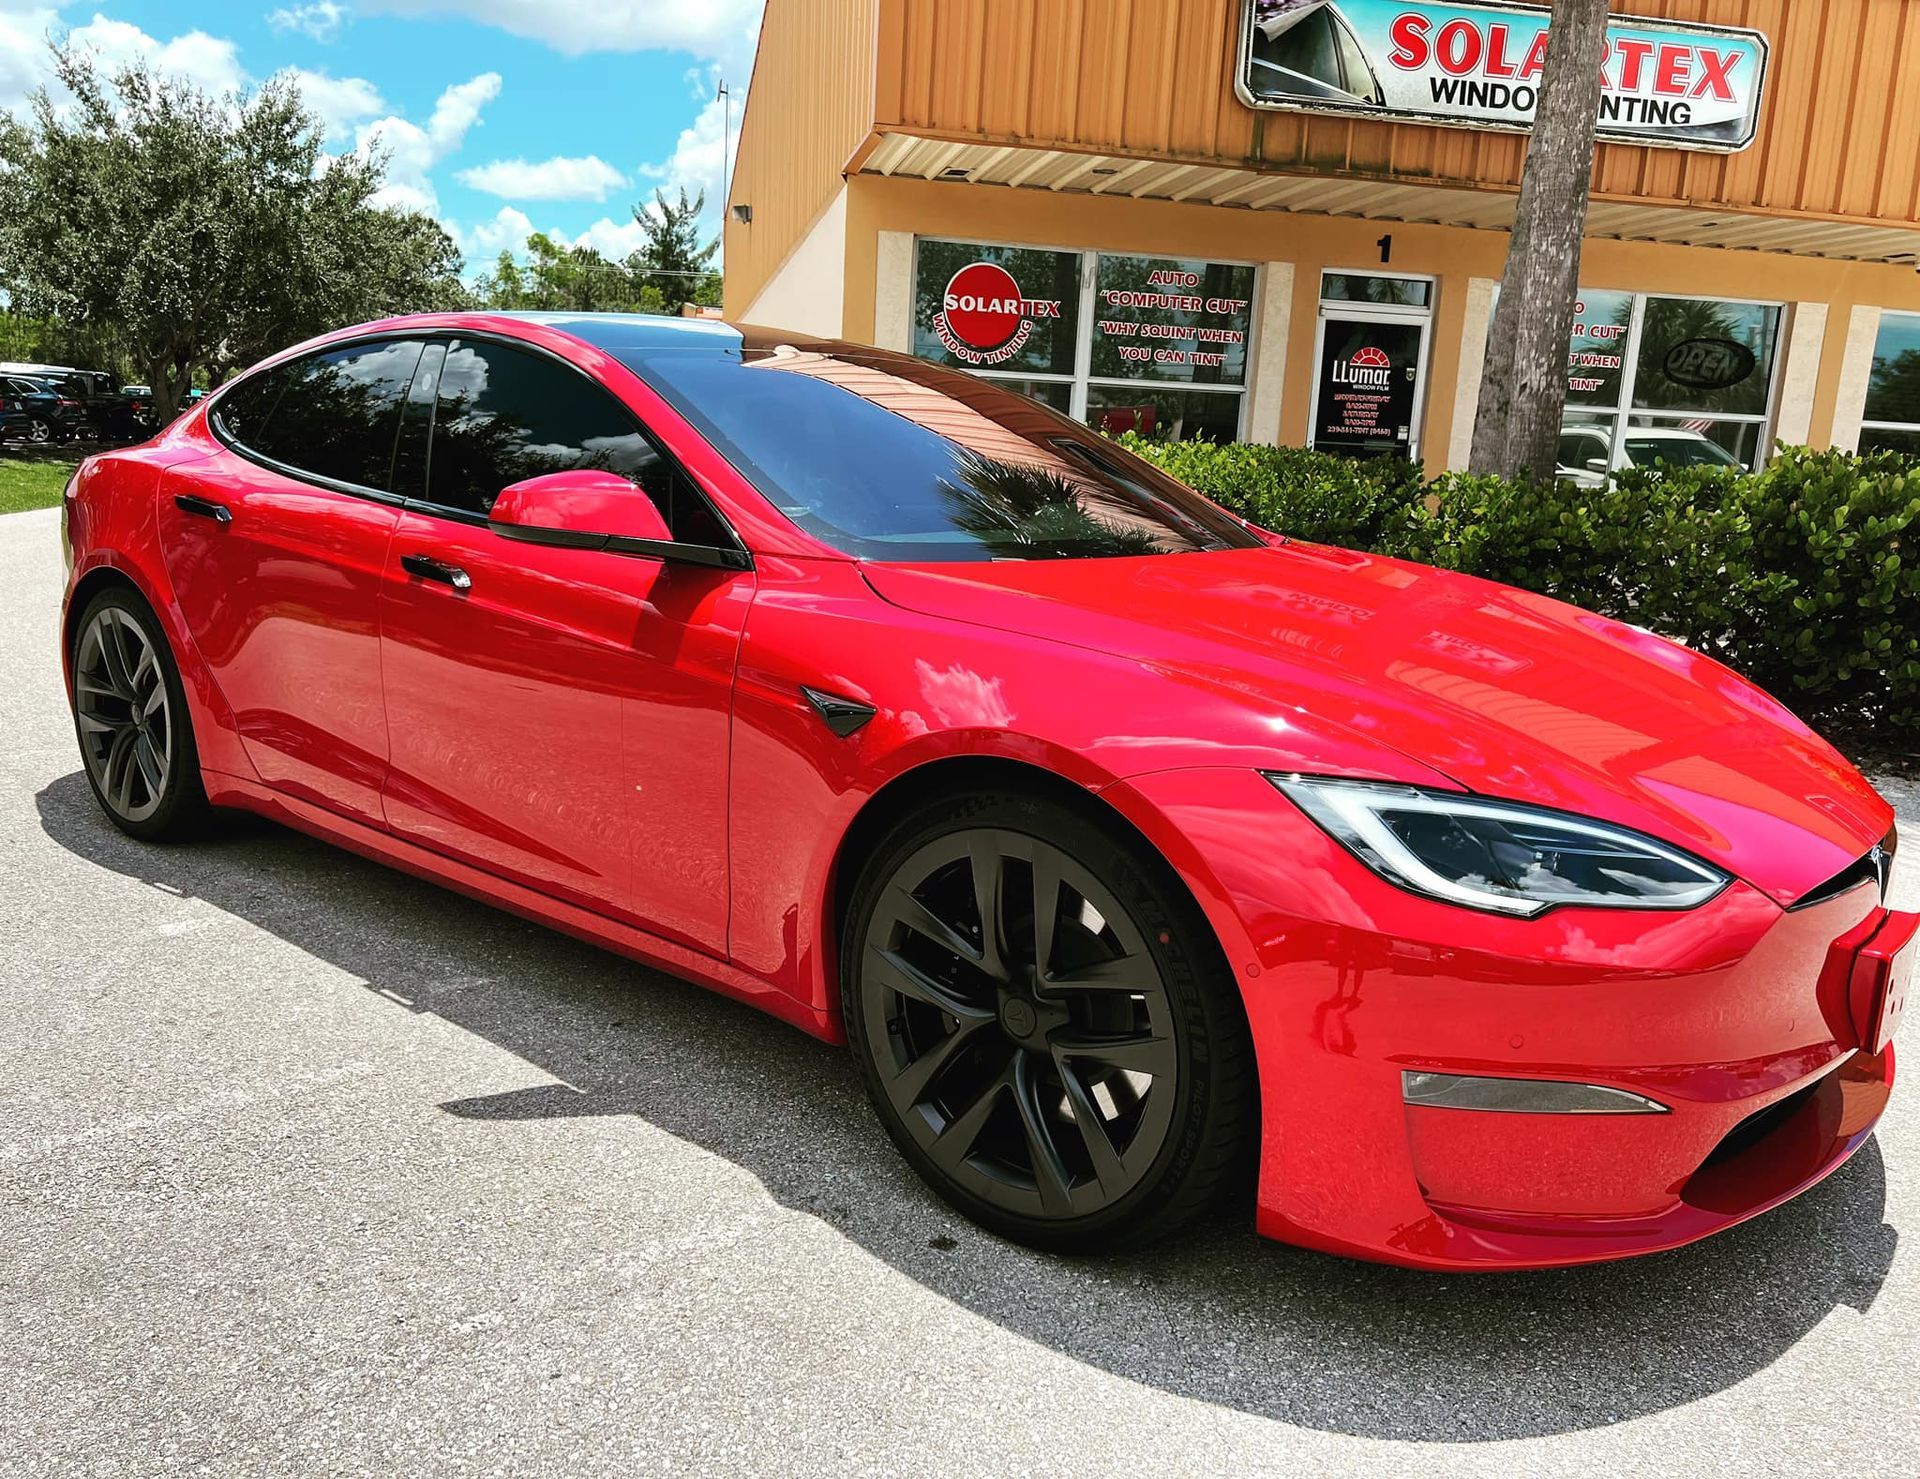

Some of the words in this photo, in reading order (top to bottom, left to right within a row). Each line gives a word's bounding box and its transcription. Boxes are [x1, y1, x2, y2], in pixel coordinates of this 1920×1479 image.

[1388, 13, 1745, 104] SOLATEX
[1429, 76, 1540, 112] WINDO
[1599, 94, 1691, 126] NTING
[1377, 234, 1392, 263] 1
[1147, 270, 1199, 287] AUTO
[945, 294, 1060, 318] SOLARTEX
[931, 311, 983, 365] WINDOW
[985, 319, 1034, 365] TINTING
[1140, 323, 1196, 341] SQUINT
[1198, 327, 1244, 345] WHEN
[1118, 345, 1151, 361] YOU
[1153, 348, 1185, 364] CAN
[1580, 352, 1621, 369] WHEN
[1668, 344, 1740, 380] OPEN
